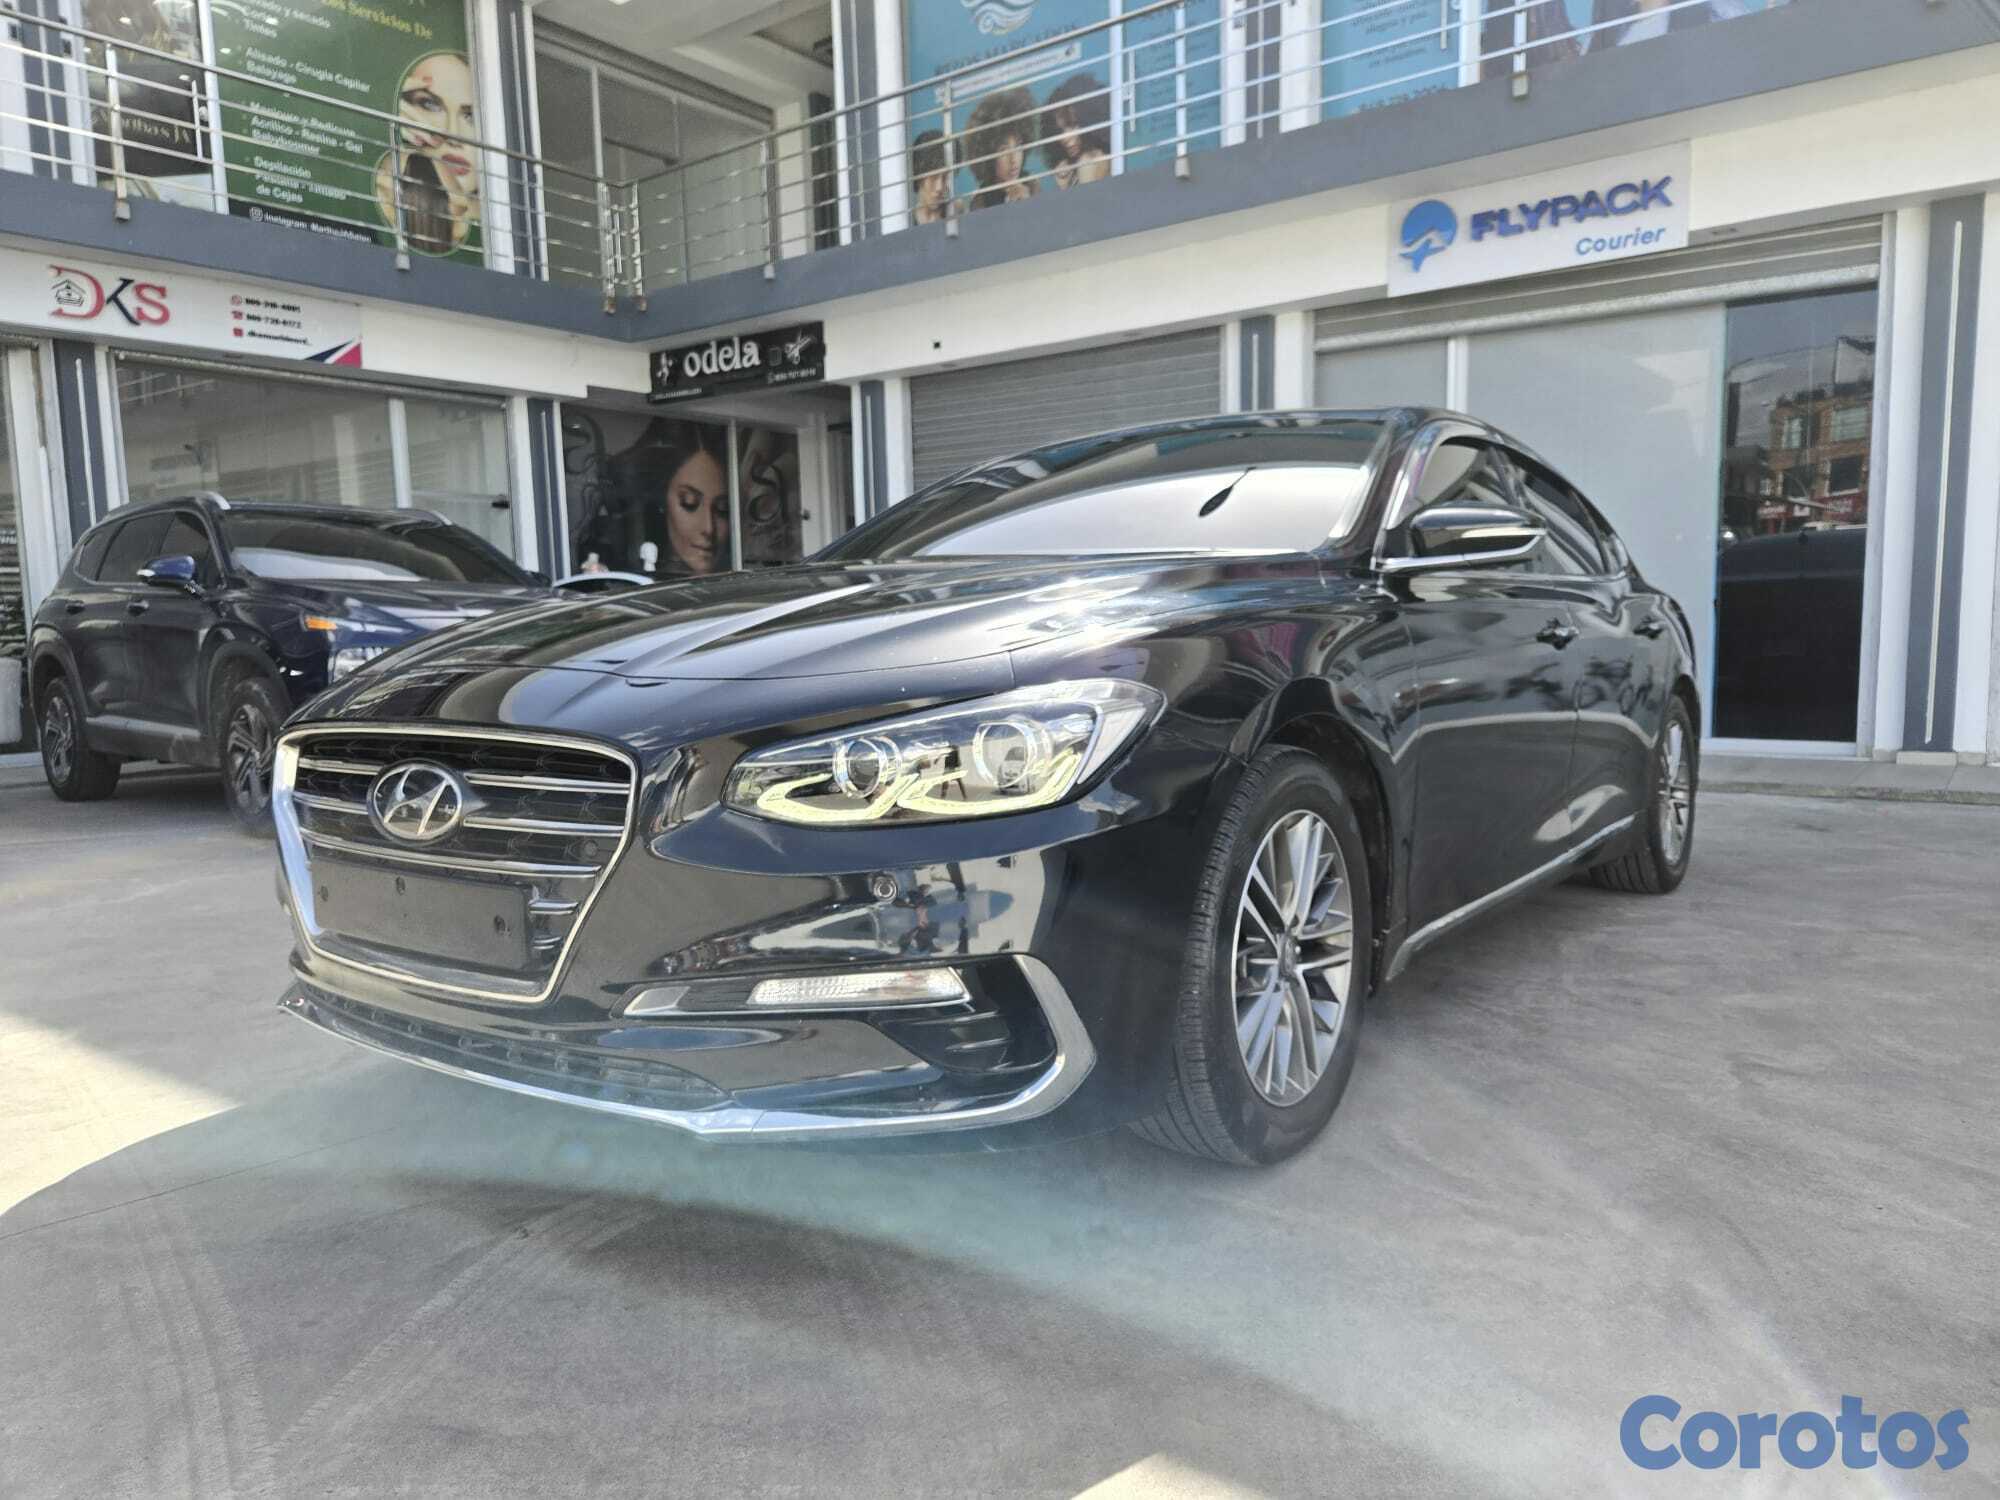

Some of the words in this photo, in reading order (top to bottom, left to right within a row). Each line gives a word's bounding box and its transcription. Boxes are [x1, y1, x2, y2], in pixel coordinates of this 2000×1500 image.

[1469, 175, 1674, 242] FLYPACK
[1575, 226, 1667, 257] Courier
[47, 264, 171, 326] DKS
[683, 336, 761, 378] odela
